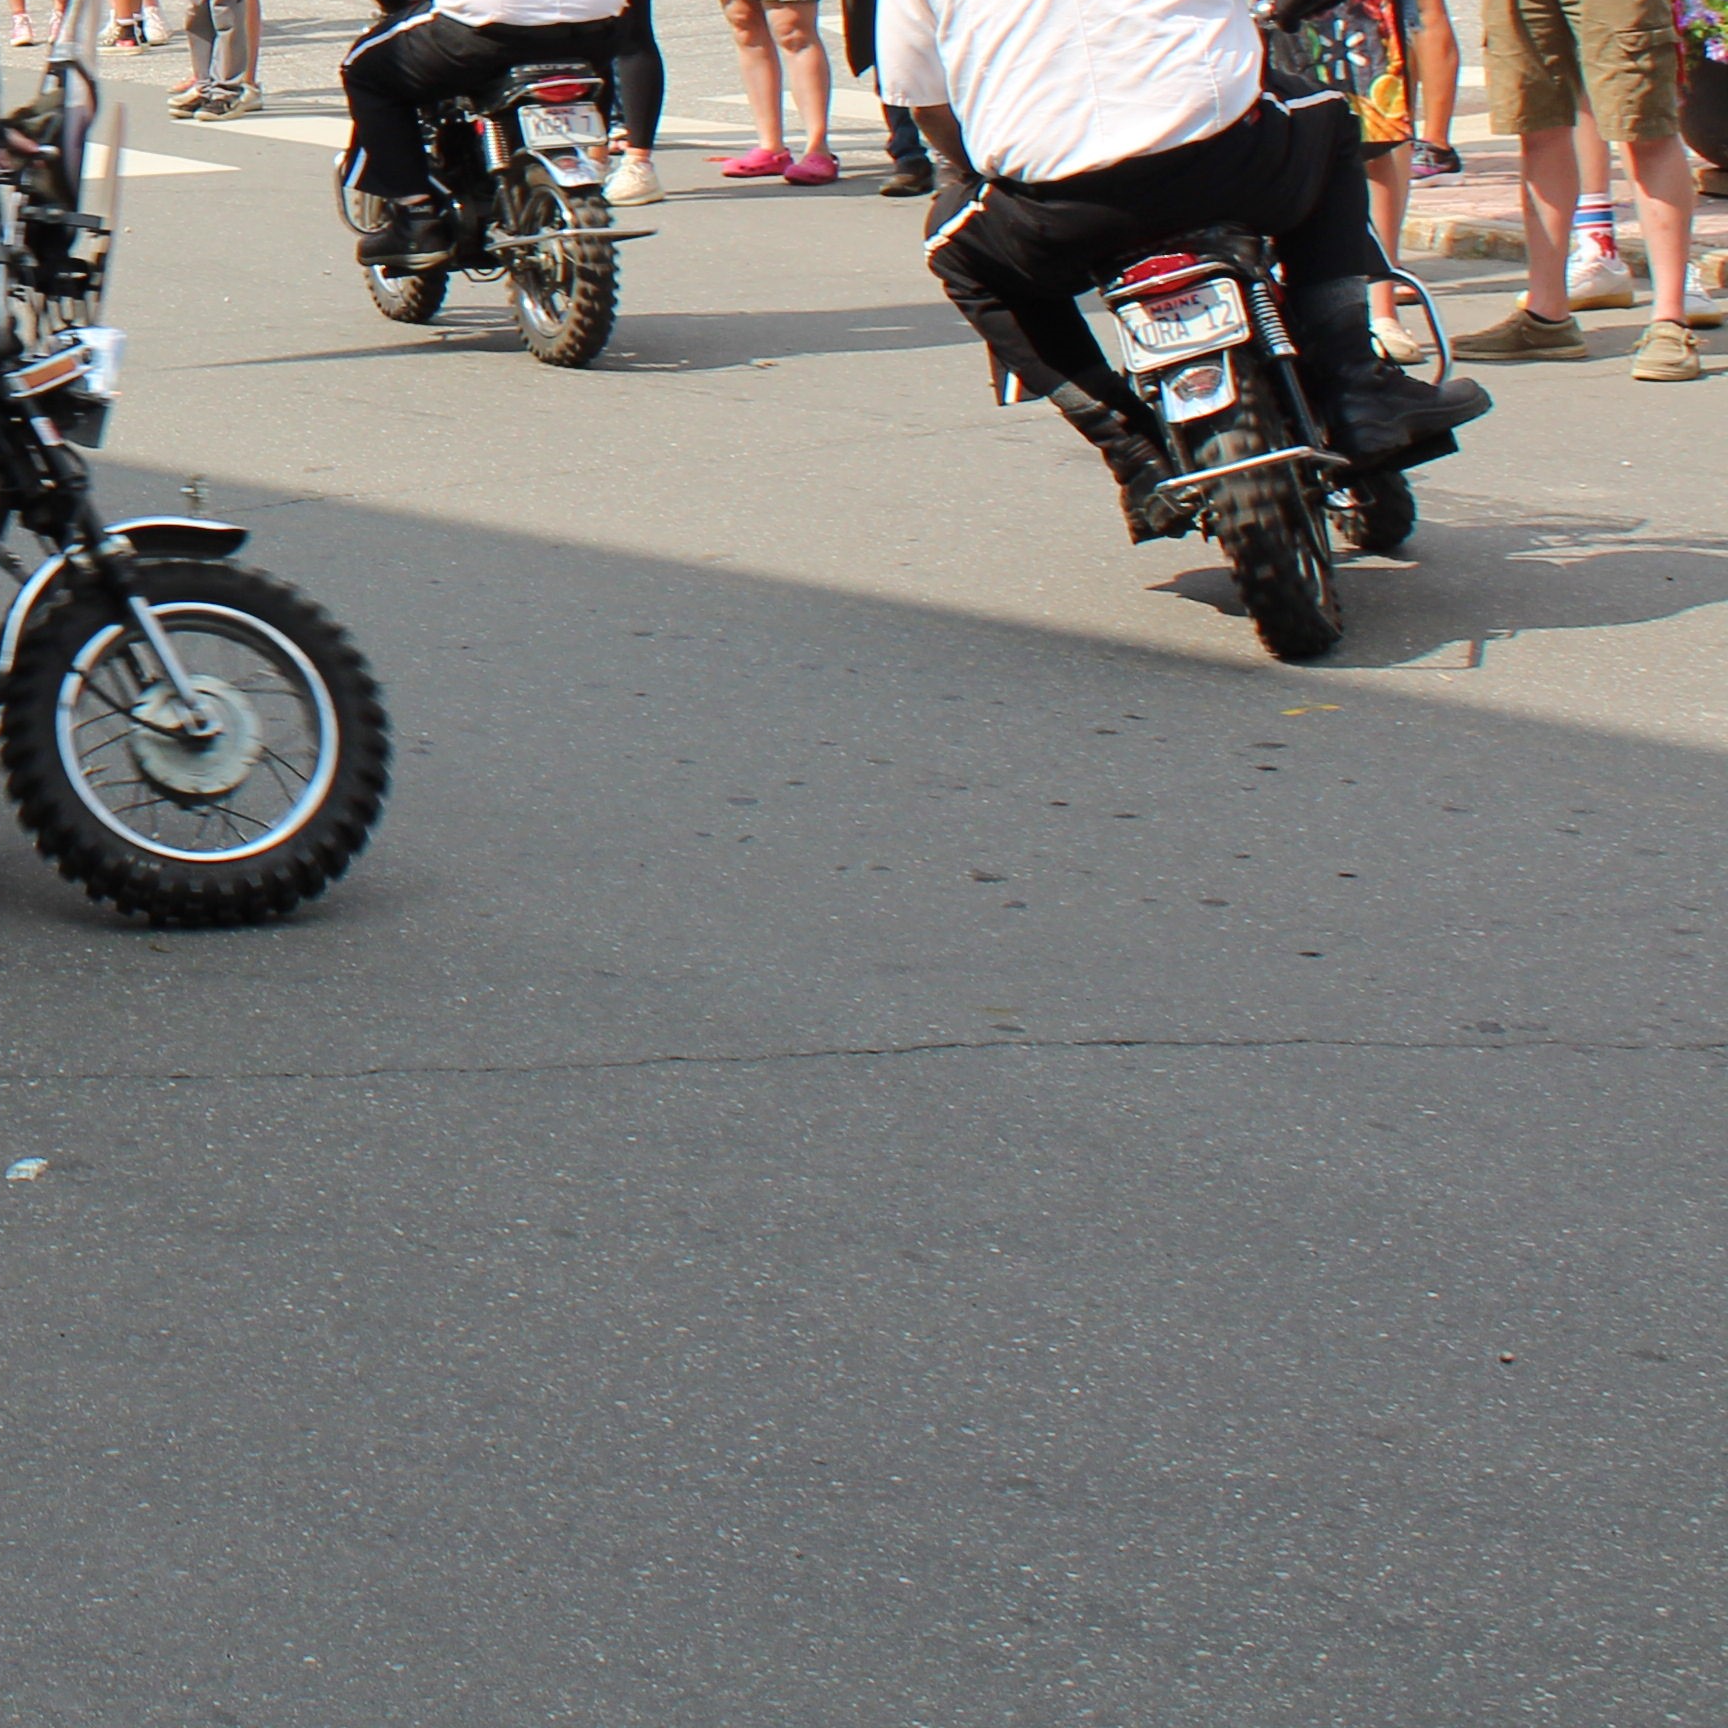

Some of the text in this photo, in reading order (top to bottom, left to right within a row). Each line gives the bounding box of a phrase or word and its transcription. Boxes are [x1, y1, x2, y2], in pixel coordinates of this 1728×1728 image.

[580, 115, 591, 132] 7
[1149, 293, 1201, 314] MAINE
[1128, 299, 1236, 354] KORA 12
